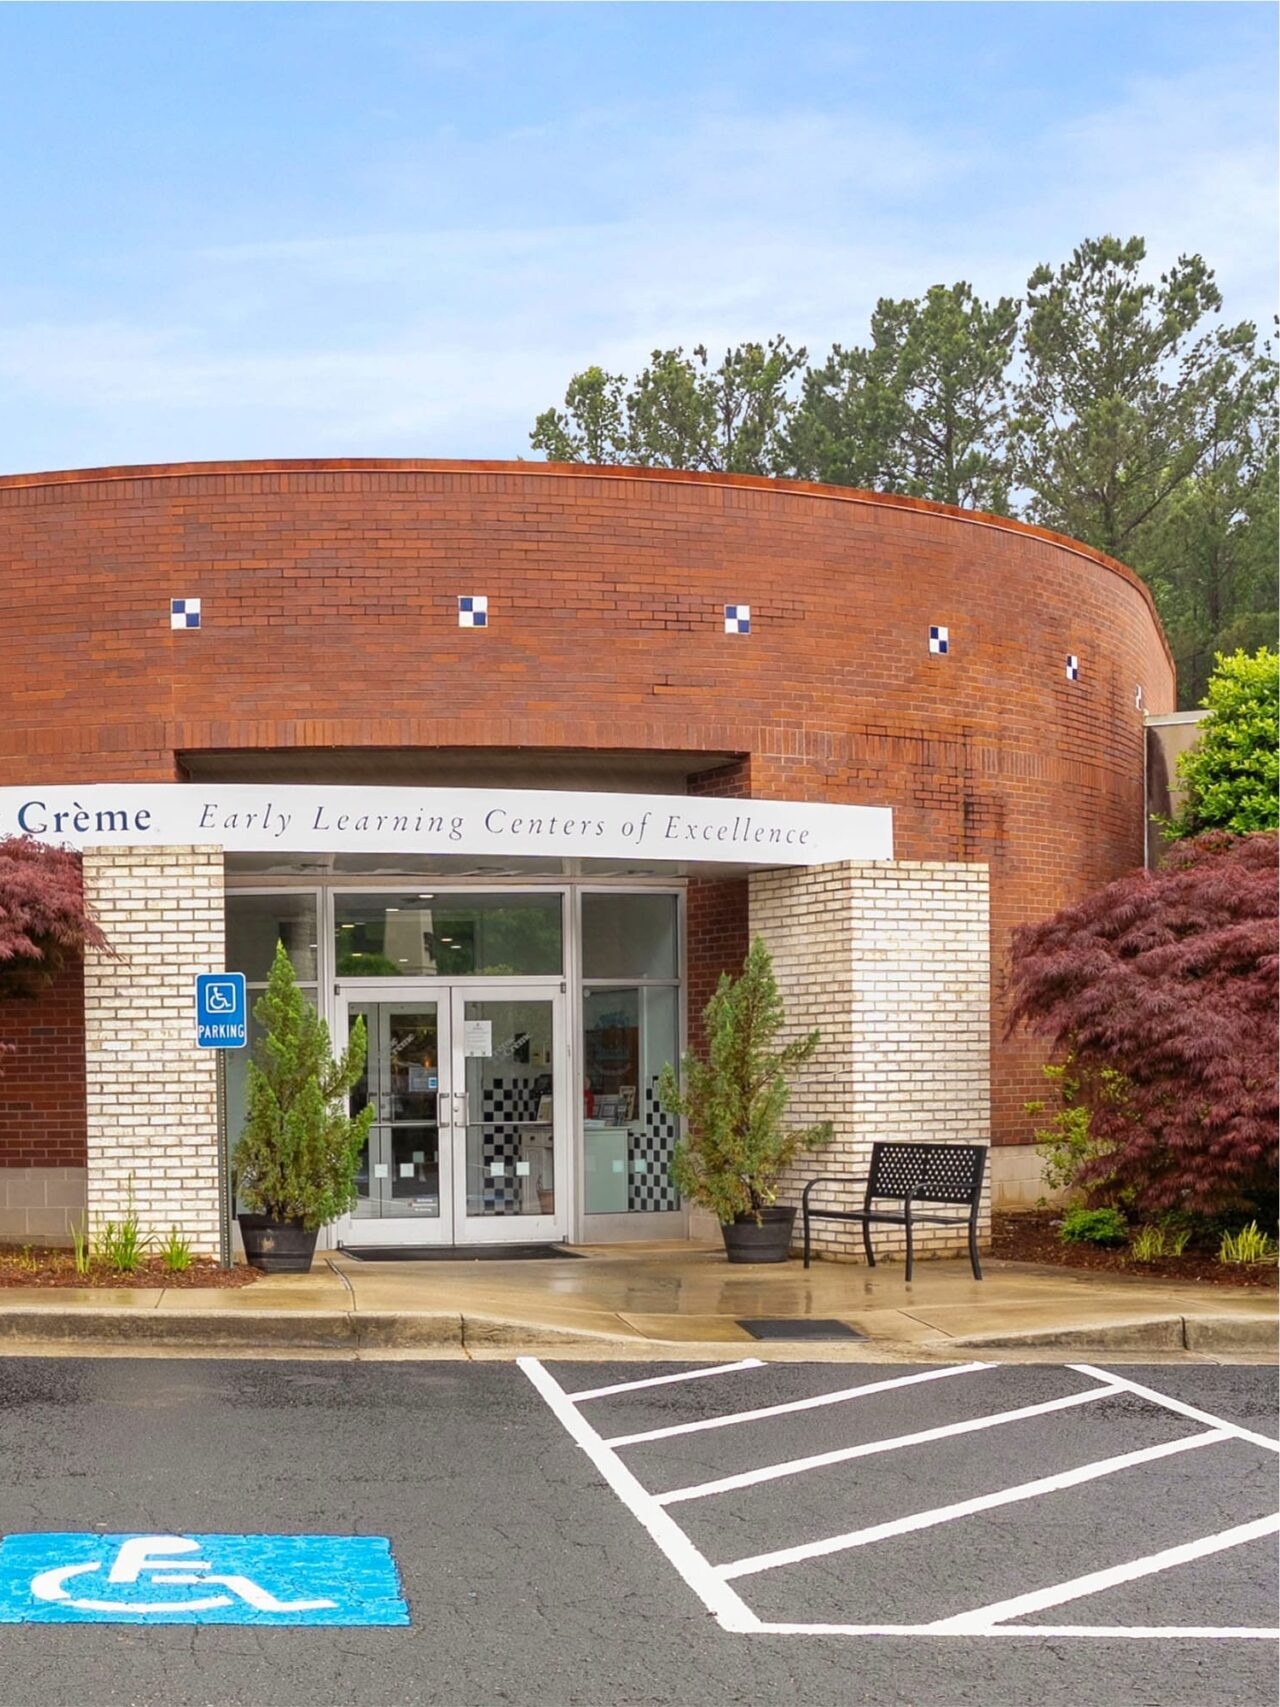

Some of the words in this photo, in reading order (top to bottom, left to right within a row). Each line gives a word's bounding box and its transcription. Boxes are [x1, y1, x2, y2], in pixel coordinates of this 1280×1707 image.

[17, 801, 151, 834] Crème
[198, 803, 292, 838] Early
[312, 806, 464, 841] Learning
[484, 808, 605, 837] Centers
[621, 811, 652, 845] of
[664, 815, 810, 845] Excellence
[198, 1024, 245, 1039] PARKING
